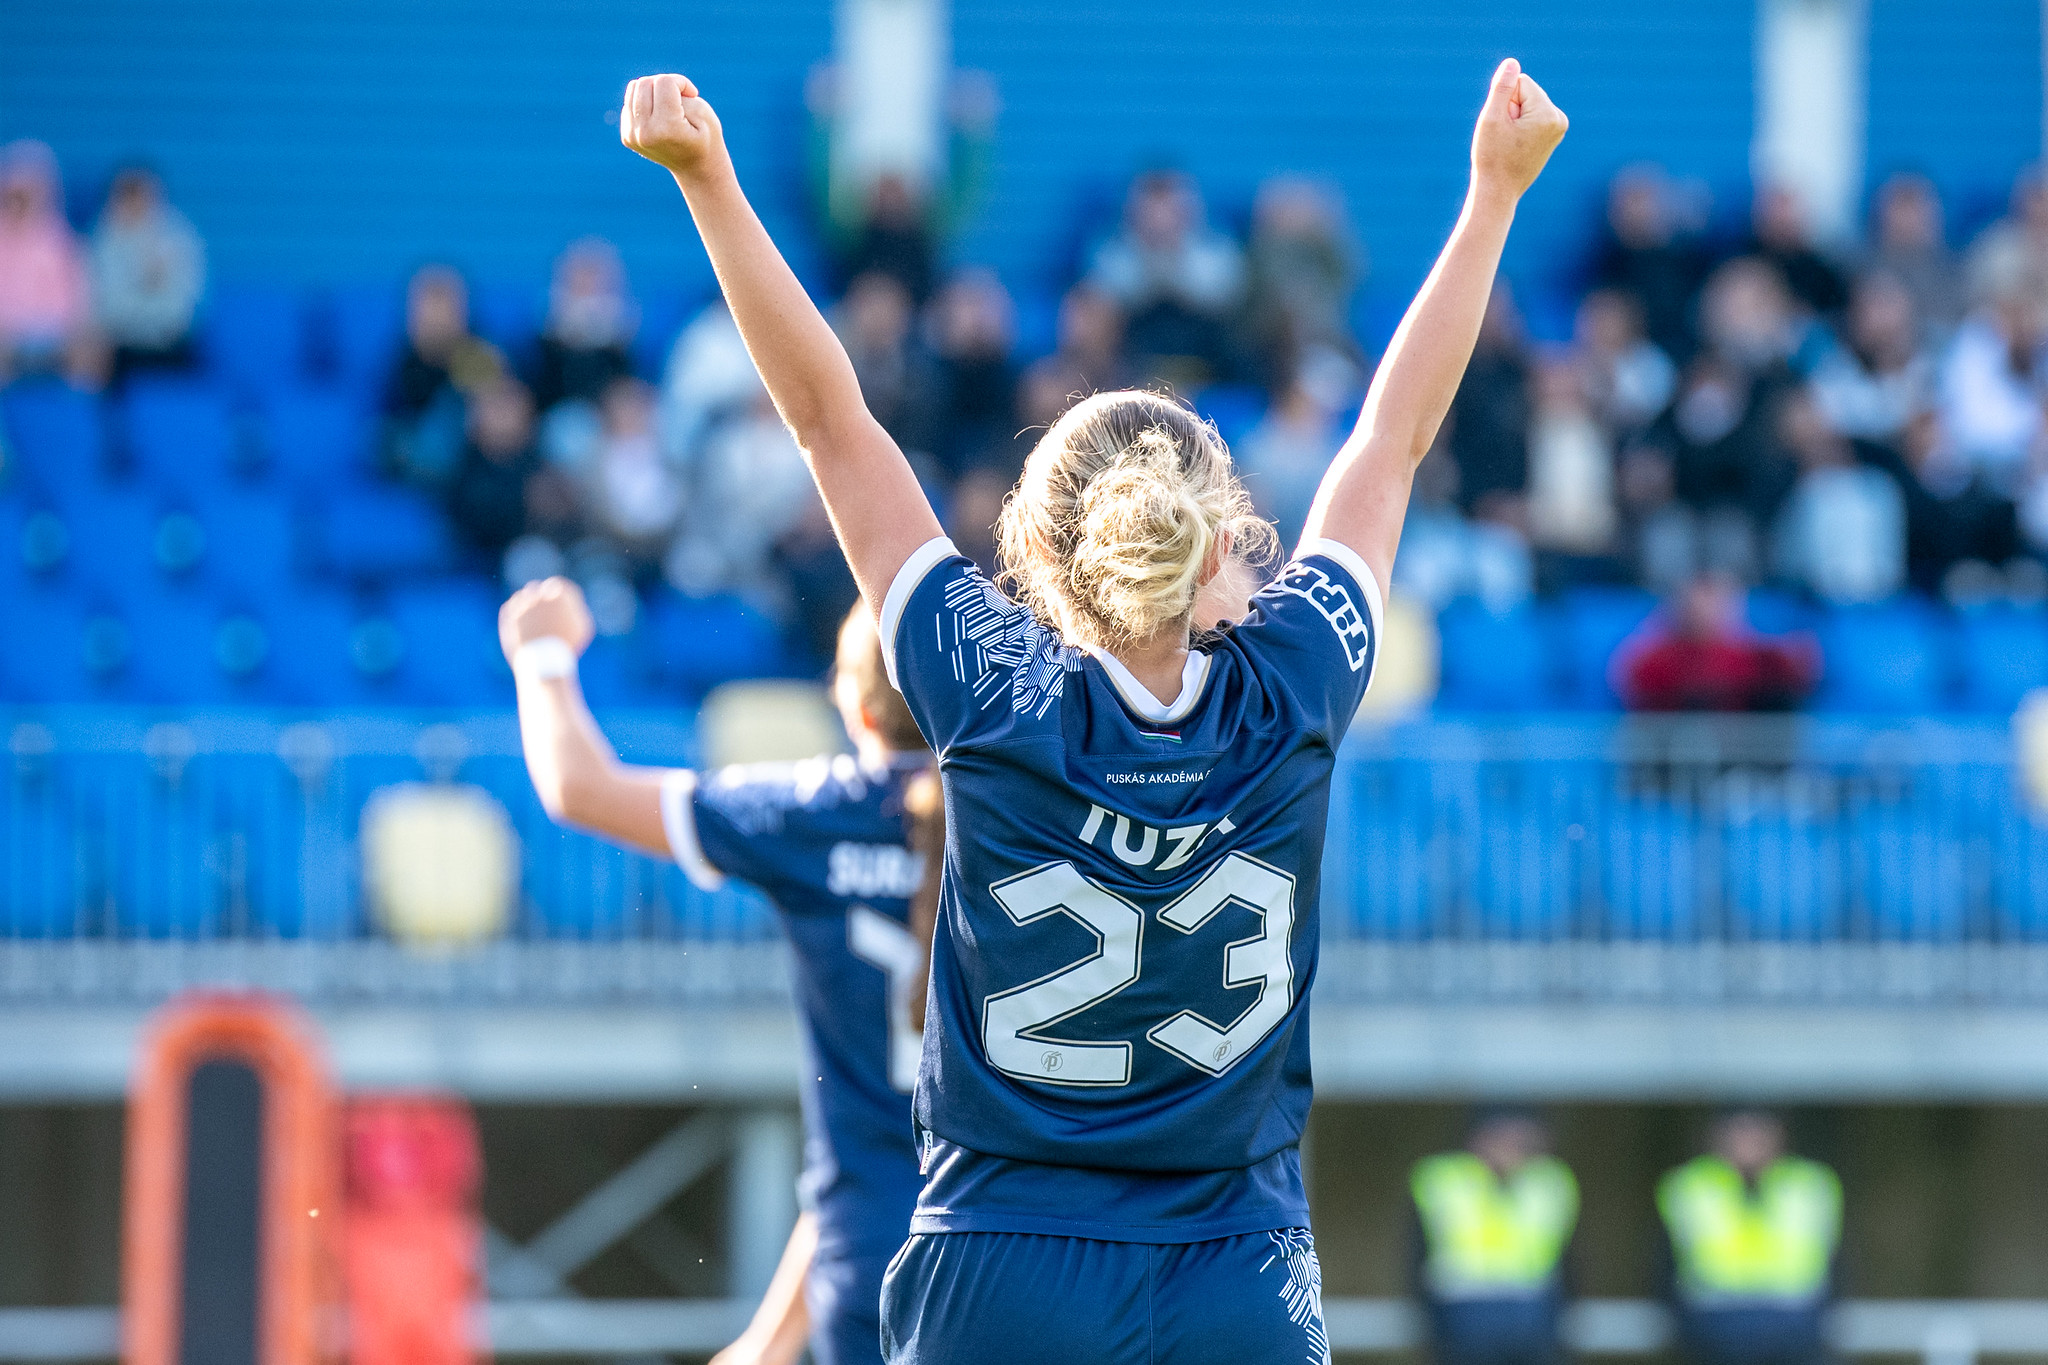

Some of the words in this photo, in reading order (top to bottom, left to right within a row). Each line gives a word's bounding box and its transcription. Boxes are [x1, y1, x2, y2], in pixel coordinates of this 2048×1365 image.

[1106, 772, 1146, 784] PUSKÁS
[1148, 770, 1204, 784] AKADÉMIA
[1079, 803, 1237, 871] TUZ
[982, 851, 1296, 1087] 23
